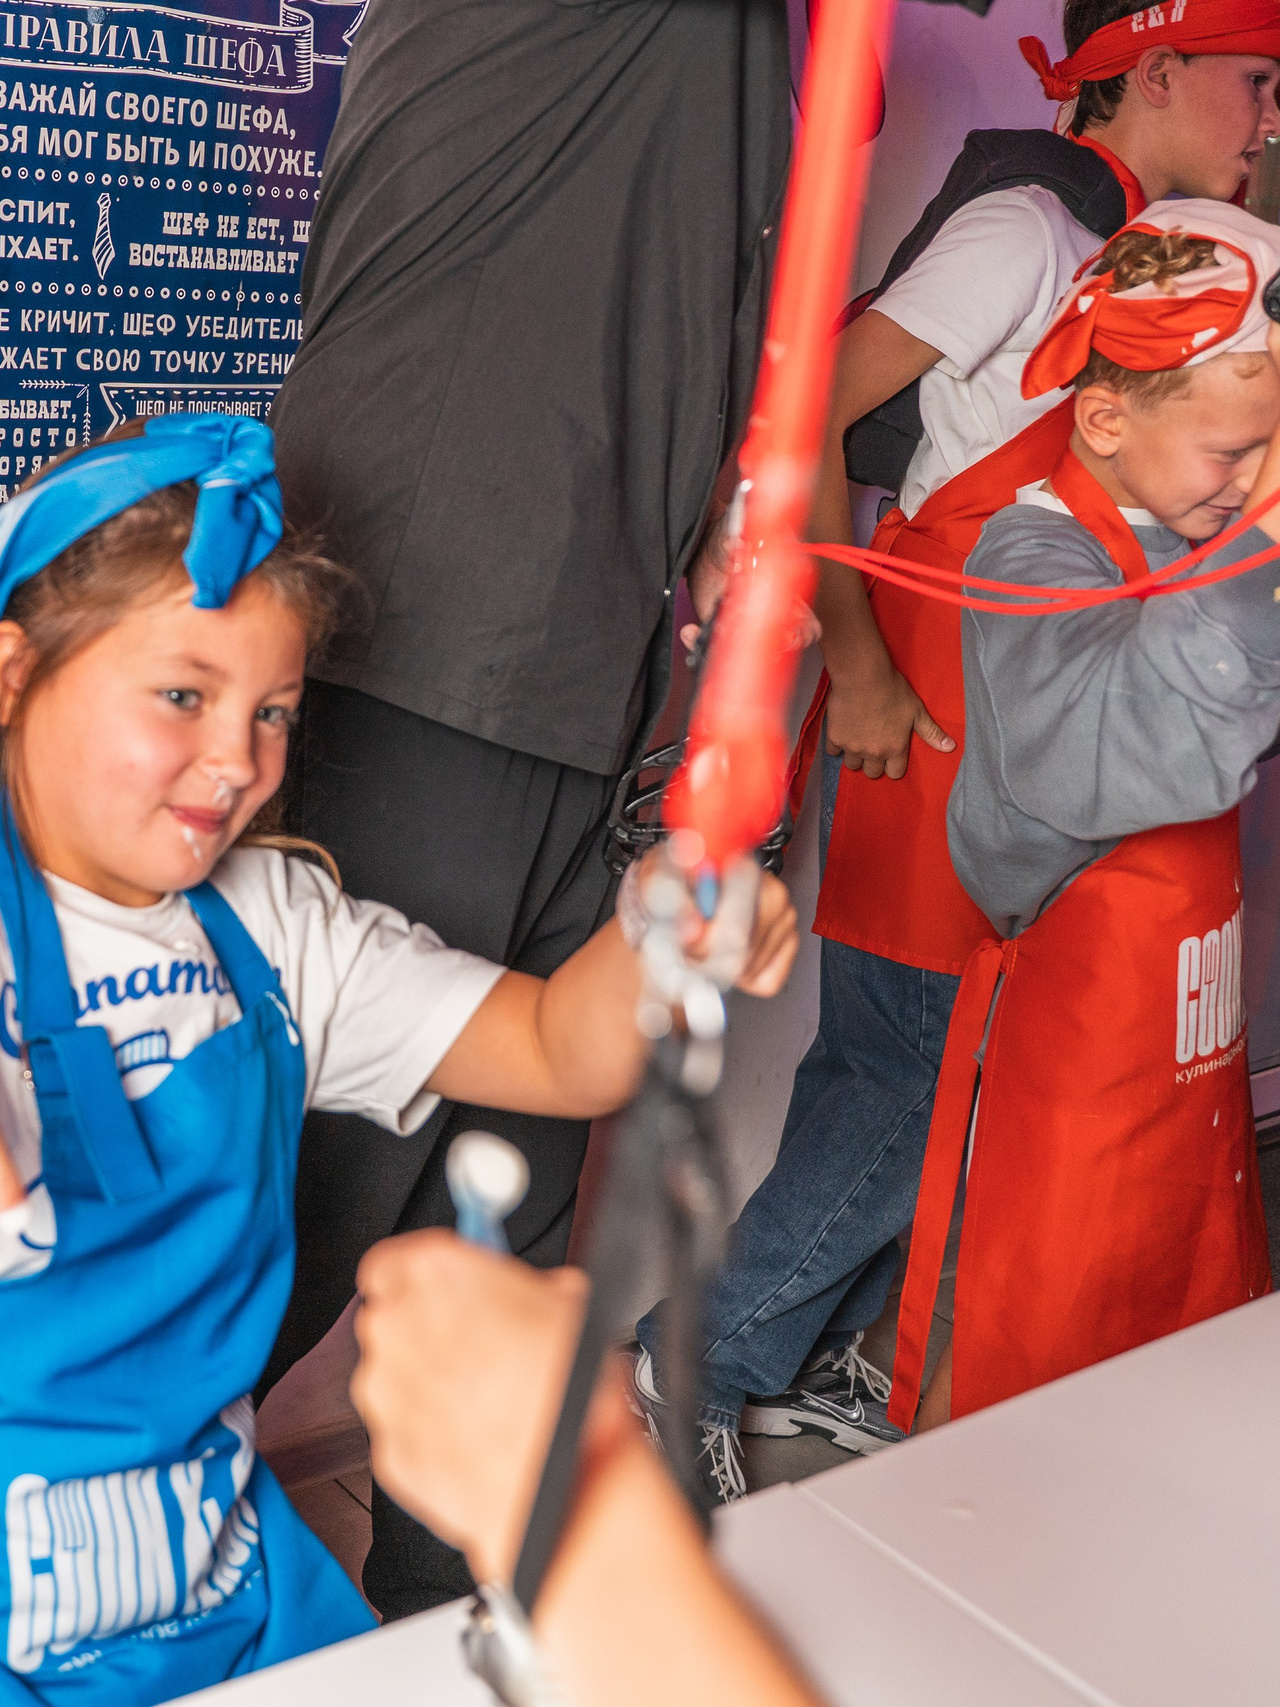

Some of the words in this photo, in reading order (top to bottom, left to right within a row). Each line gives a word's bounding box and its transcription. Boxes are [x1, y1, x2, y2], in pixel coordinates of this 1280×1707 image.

[183, 34, 287, 78] ШЕФА
[105, 90, 208, 127] СВОЕГО
[216, 101, 296, 141] ШЕФА,
[37, 127, 99, 160] МОГ
[106, 132, 180, 167] БЫТЬ
[187, 139, 206, 169] И
[213, 142, 323, 178] ПОХУЖЕ.
[162, 211, 210, 237] ШЕФ
[216, 214, 240, 238] НЕ
[246, 216, 285, 246] ЕСТ,
[128, 241, 300, 275] ВОСТАНАВЛИВАЕТ
[19, 309, 115, 337] КРИЧИТ,
[122, 312, 176, 337] ШЕФ
[75, 348, 141, 372] СВОЮ
[150, 349, 226, 375] ТОЧКУ
[231, 352, 296, 376] ЗРЕНИ
[135, 399, 166, 416] ШЕФ
[169, 400, 185, 415] НЕ
[188, 400, 263, 417] ПОЧЕСЫВАЕТ
